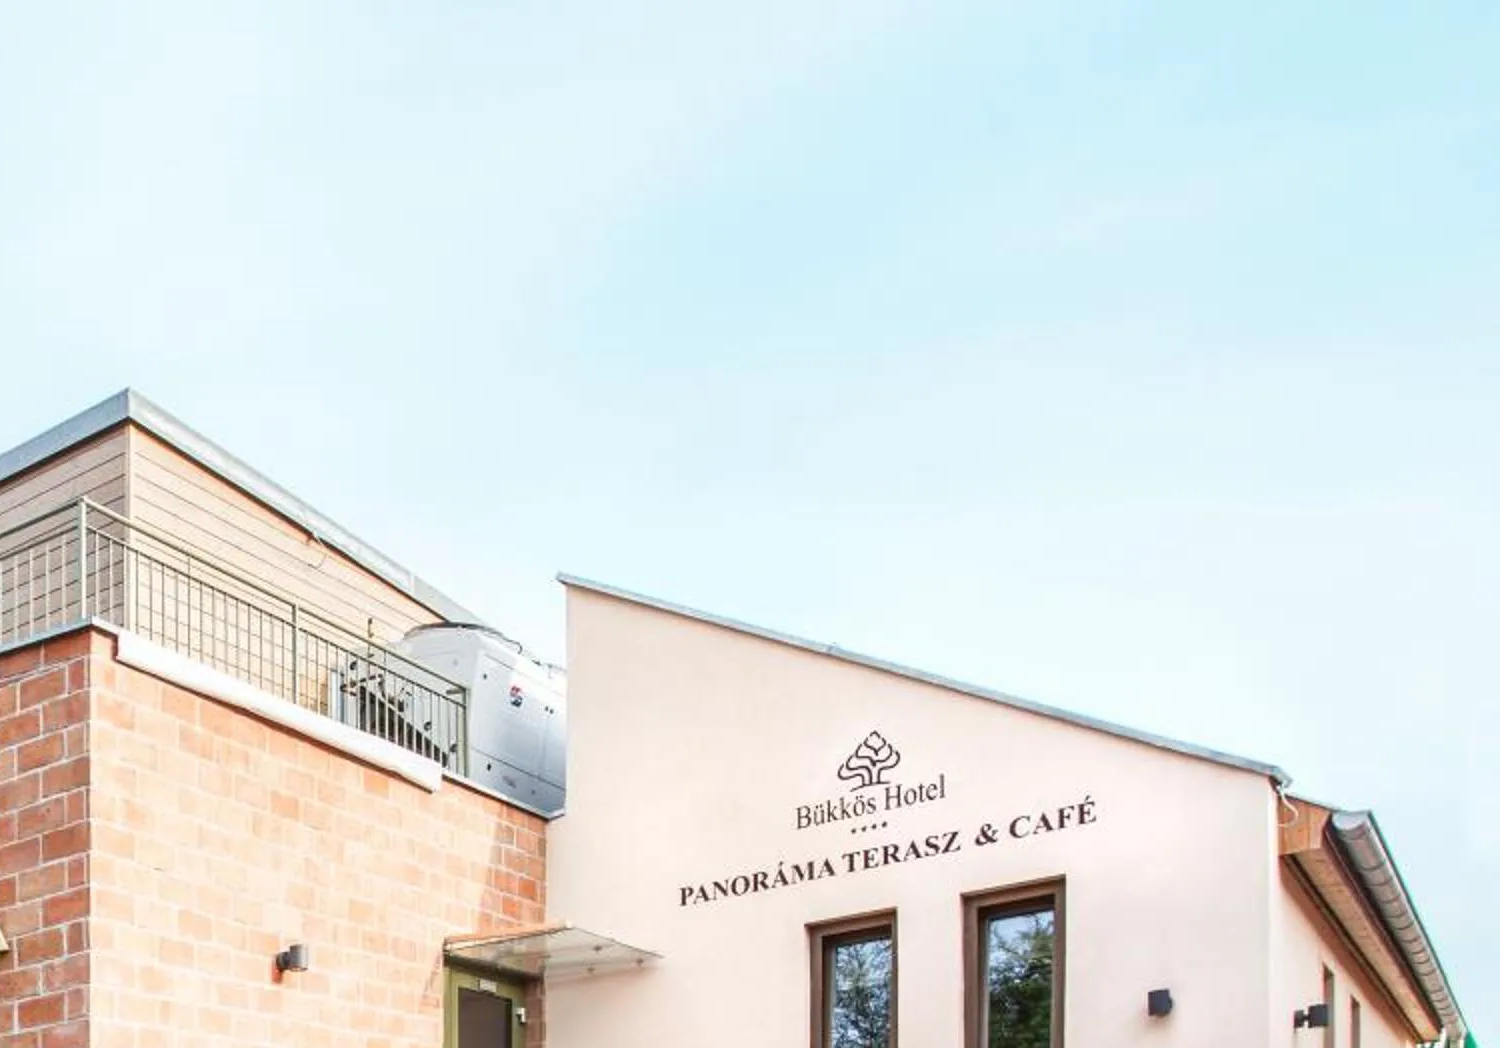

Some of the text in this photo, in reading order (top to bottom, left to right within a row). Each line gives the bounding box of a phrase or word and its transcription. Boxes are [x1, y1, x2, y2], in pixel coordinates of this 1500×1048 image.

[796, 773, 946, 829] Bükkös Hotel
[680, 795, 1098, 906] PANORÁMA TERASZ & CAFÉ
